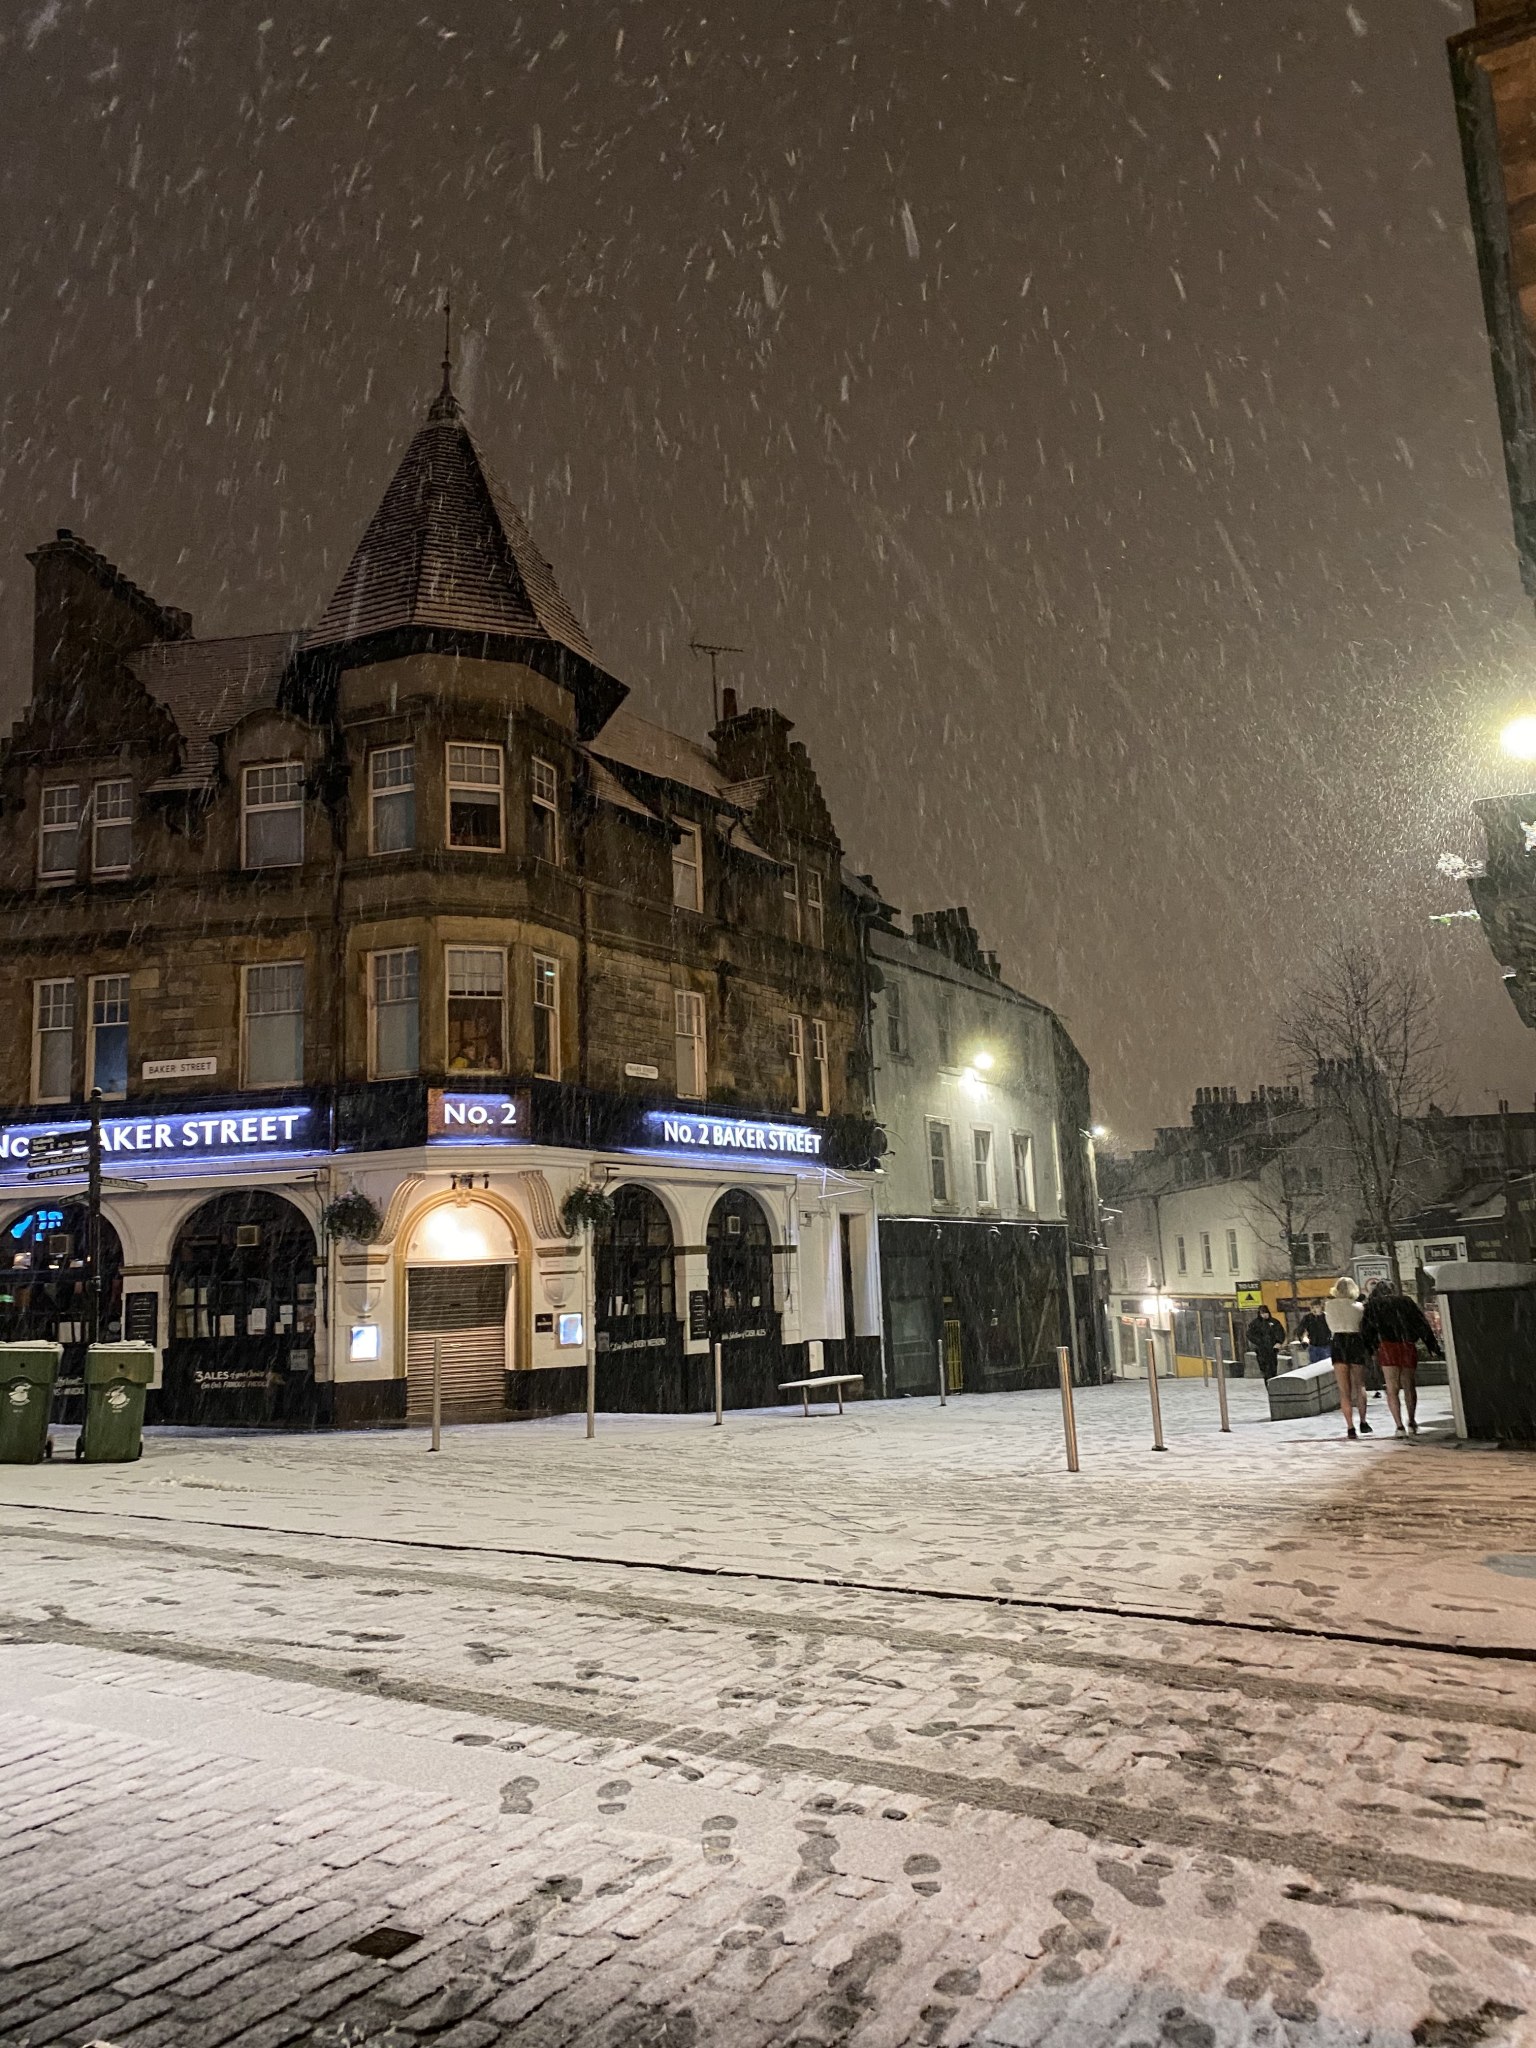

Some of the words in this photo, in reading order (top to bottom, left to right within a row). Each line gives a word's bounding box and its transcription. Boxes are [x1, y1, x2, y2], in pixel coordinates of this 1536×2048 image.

[148, 1064, 176, 1074] BAKER
[180, 1062, 211, 1072] STREET
[444, 1103, 494, 1124] No.
[500, 1103, 517, 1124] 2
[73, 1123, 173, 1152] AKER
[182, 1115, 299, 1147] STREET
[664, 1120, 696, 1144] No.
[698, 1123, 710, 1145] 2
[713, 1125, 767, 1150] BAKER
[768, 1130, 822, 1154] STREET
